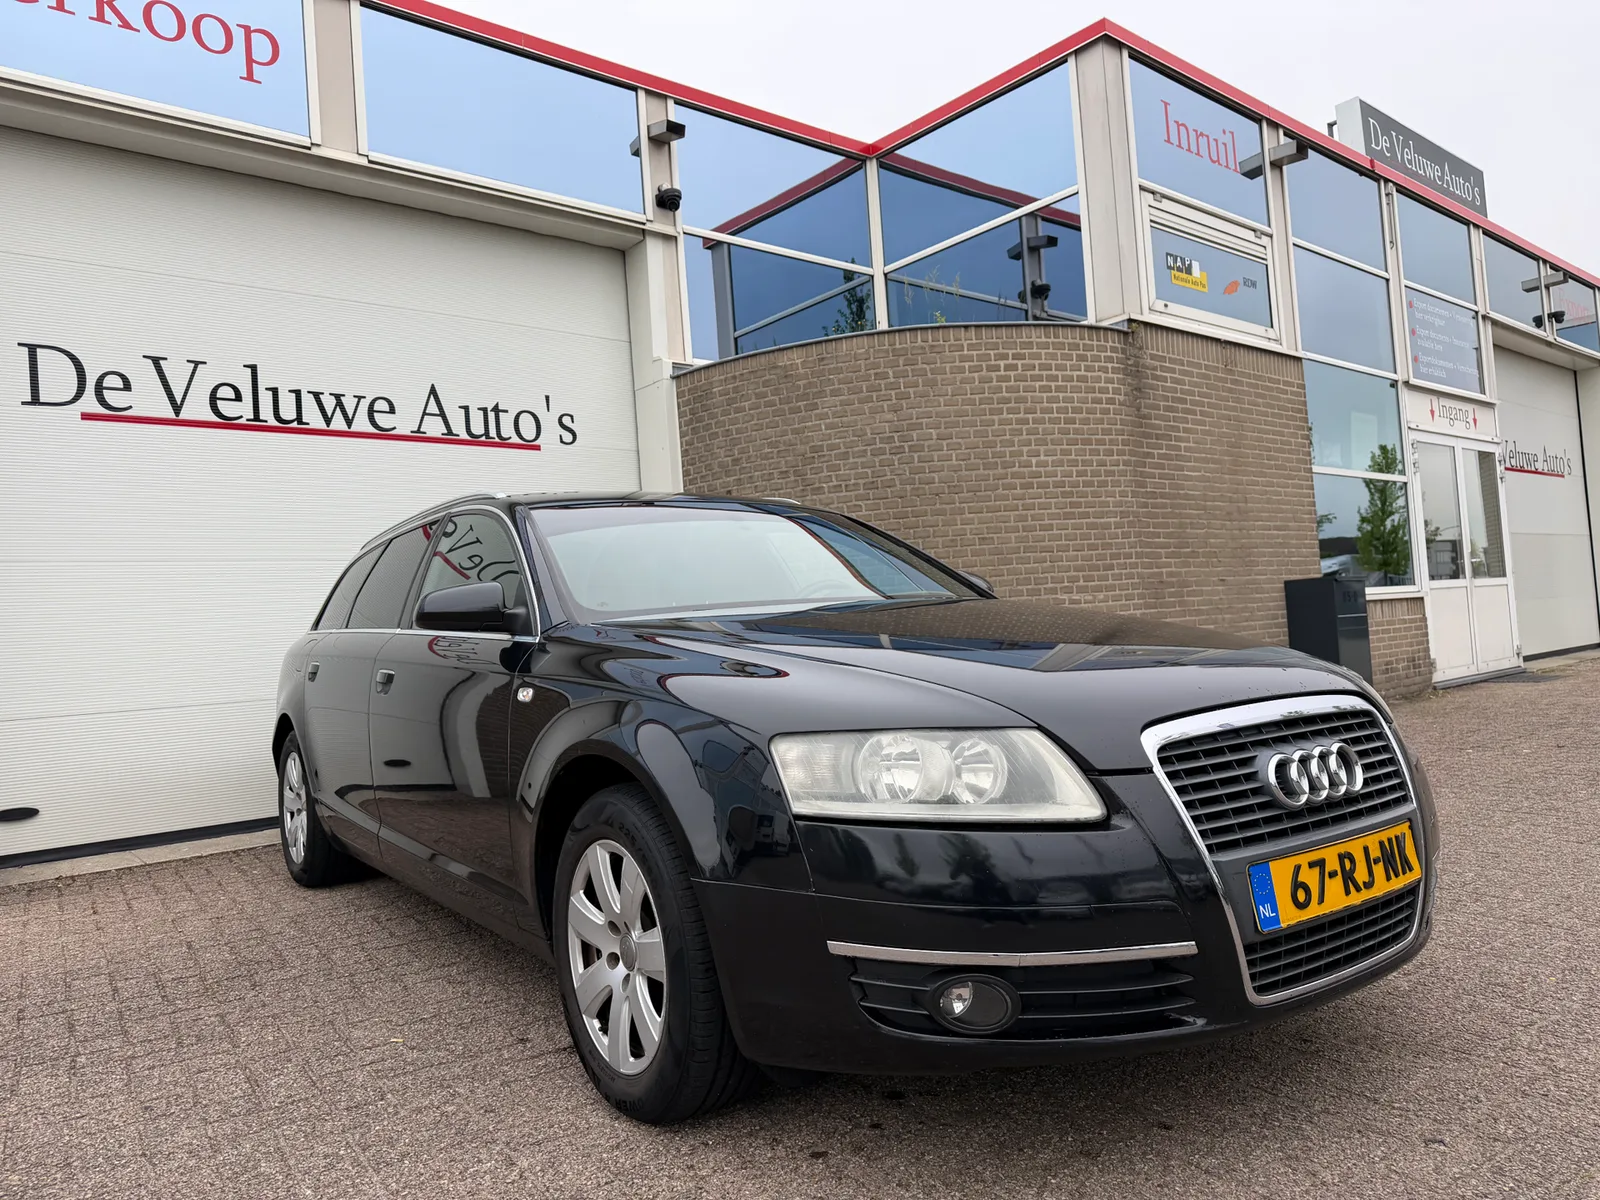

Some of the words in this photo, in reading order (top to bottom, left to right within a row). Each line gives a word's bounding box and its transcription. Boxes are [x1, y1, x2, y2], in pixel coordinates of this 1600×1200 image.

[1160, 99, 1240, 174] Inruil
[1368, 117, 1391, 157] De
[1391, 130, 1442, 185] Veluwe
[1443, 162, 1481, 206] Auto's
[1167, 255, 1191, 268] NAP
[1243, 277, 1257, 290] RDW
[17, 342, 133, 412] De
[142, 355, 397, 432] Veluwe
[410, 383, 578, 446] Auto's
[1437, 397, 1470, 430] Ingang
[1542, 445, 1572, 475] Auto's
[1290, 832, 1414, 910] 67-RJ-NK
[1259, 903, 1276, 919] NL
